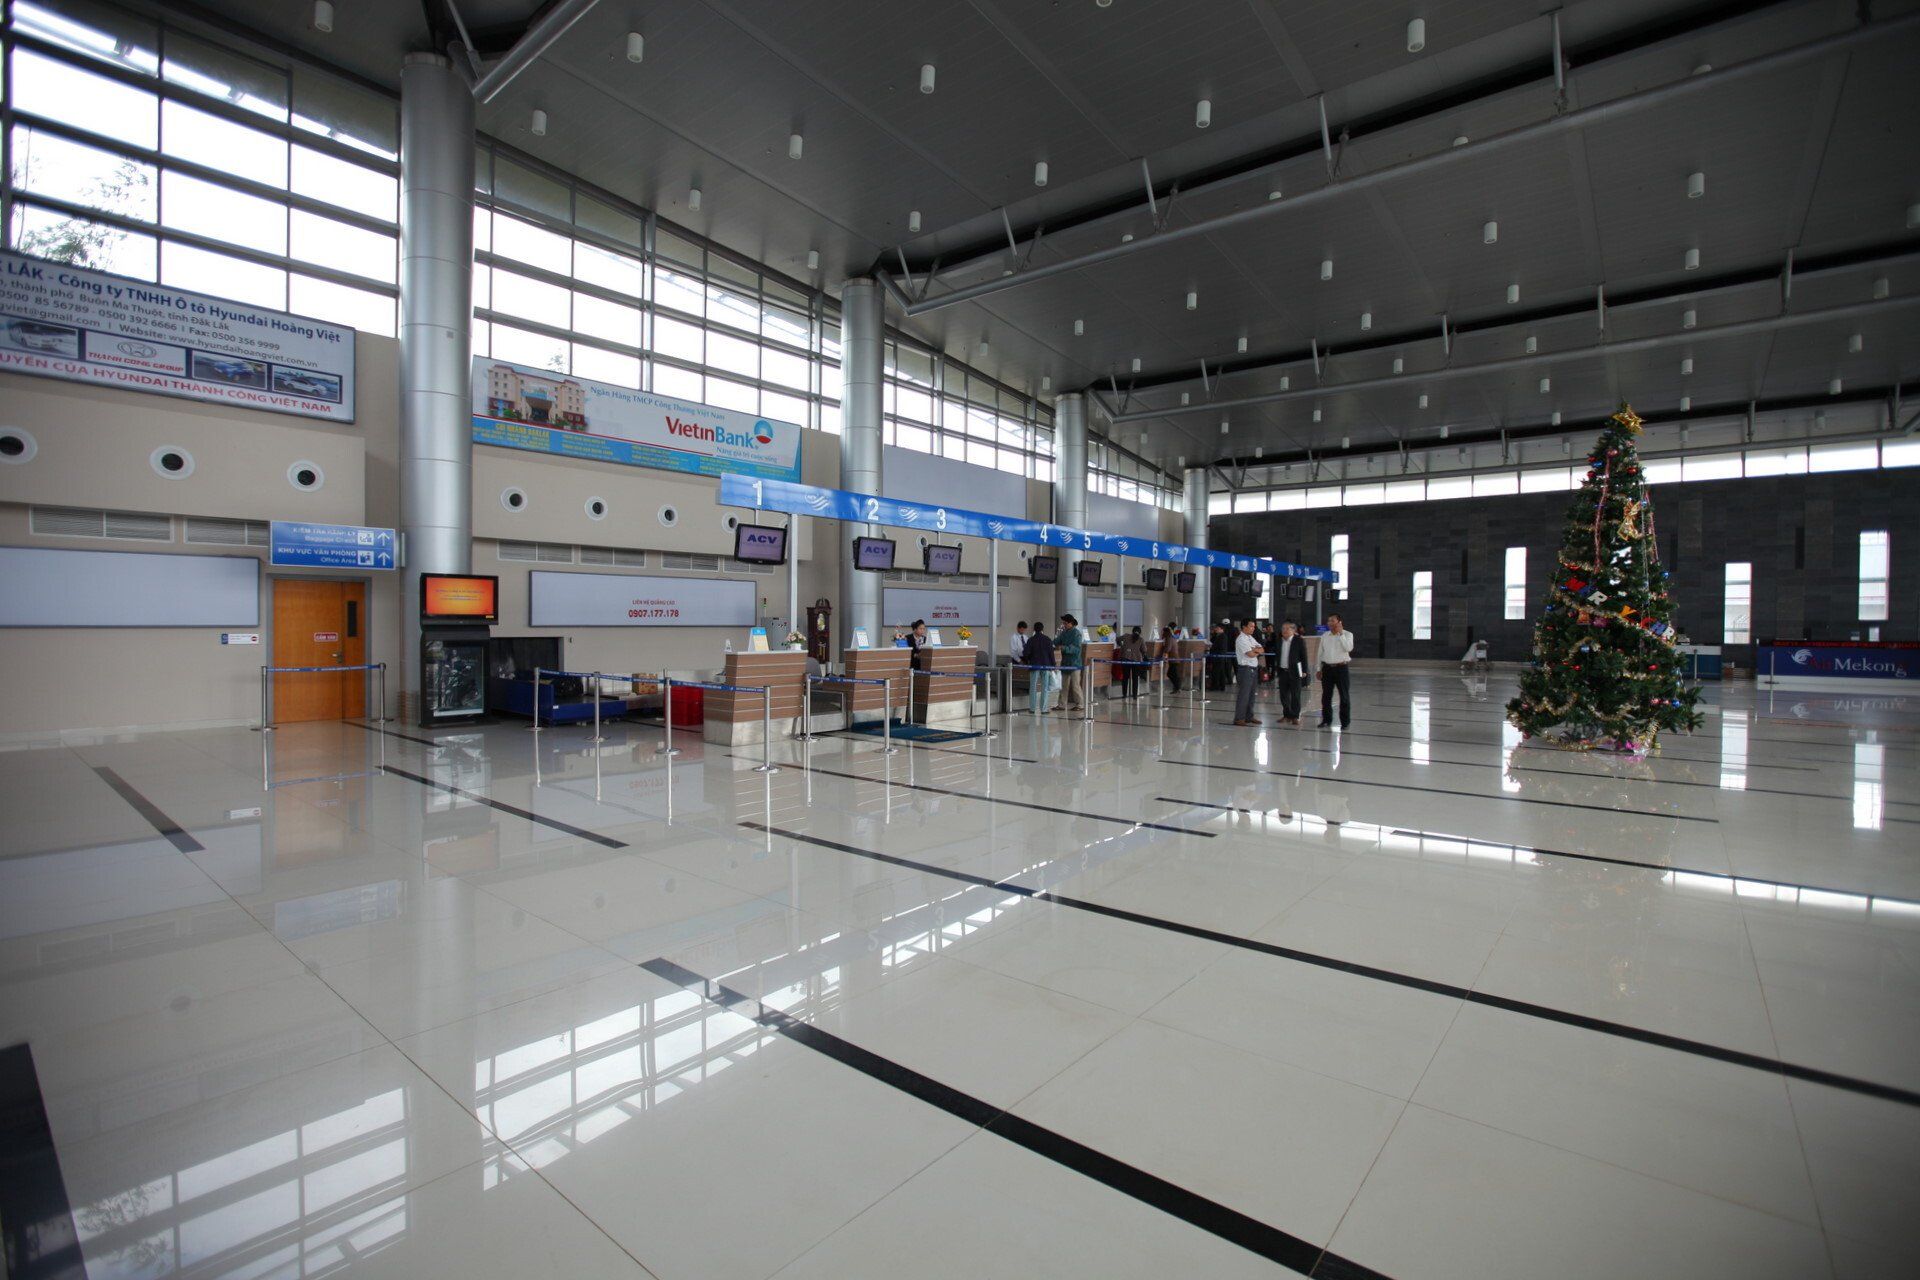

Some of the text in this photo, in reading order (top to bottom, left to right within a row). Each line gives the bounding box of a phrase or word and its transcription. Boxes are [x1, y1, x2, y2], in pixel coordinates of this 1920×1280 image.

[11, 280, 47, 295] thành
[80, 293, 110, 307] Buôn
[112, 300, 129, 311] Ma
[58, 274, 102, 295] Công
[107, 284, 123, 299] ty
[126, 287, 171, 307] TNHH
[175, 294, 187, 310] Ô
[191, 302, 206, 315] tô
[209, 305, 268, 326] Hyundai
[271, 318, 314, 339] Hoàng
[316, 328, 341, 344] Việt
[35, 296, 49, 306] 85
[53, 299, 90, 313] 56789
[98, 309, 127, 321] 0500
[129, 315, 149, 326] 392
[151, 318, 177, 331] 6666
[189, 327, 210, 337] Fax:
[212, 331, 236, 343] 0500
[238, 336, 255, 346] 356
[257, 340, 280, 351] 9999
[119, 324, 166, 341] Website:
[169, 335, 318, 368] www.hyundaihoangviet.com.vn
[153, 363, 184, 373] GROUP
[93, 368, 168, 387] HYUNDAI
[228, 388, 267, 403] CÔNG
[270, 396, 298, 408] VIỆT
[301, 402, 332, 413] NAM
[632, 395, 653, 406] TMCP
[710, 412, 726, 421] Nam
[665, 416, 755, 450] VietinBank
[752, 480, 763, 506] 1
[867, 497, 879, 521] 2
[936, 508, 947, 530] 3
[747, 534, 778, 545] ACV
[1040, 525, 1048, 542] 4
[1084, 531, 1091, 549] 5
[864, 546, 889, 555] ACV
[934, 552, 955, 561] ACV
[1152, 542, 1158, 558] 6
[1184, 547, 1189, 562] 7
[1231, 555, 1236, 568] 8
[1253, 558, 1257, 570] 9
[628, 609, 680, 618] 0907.177.178
[1833, 657, 1908, 678] Mekong
